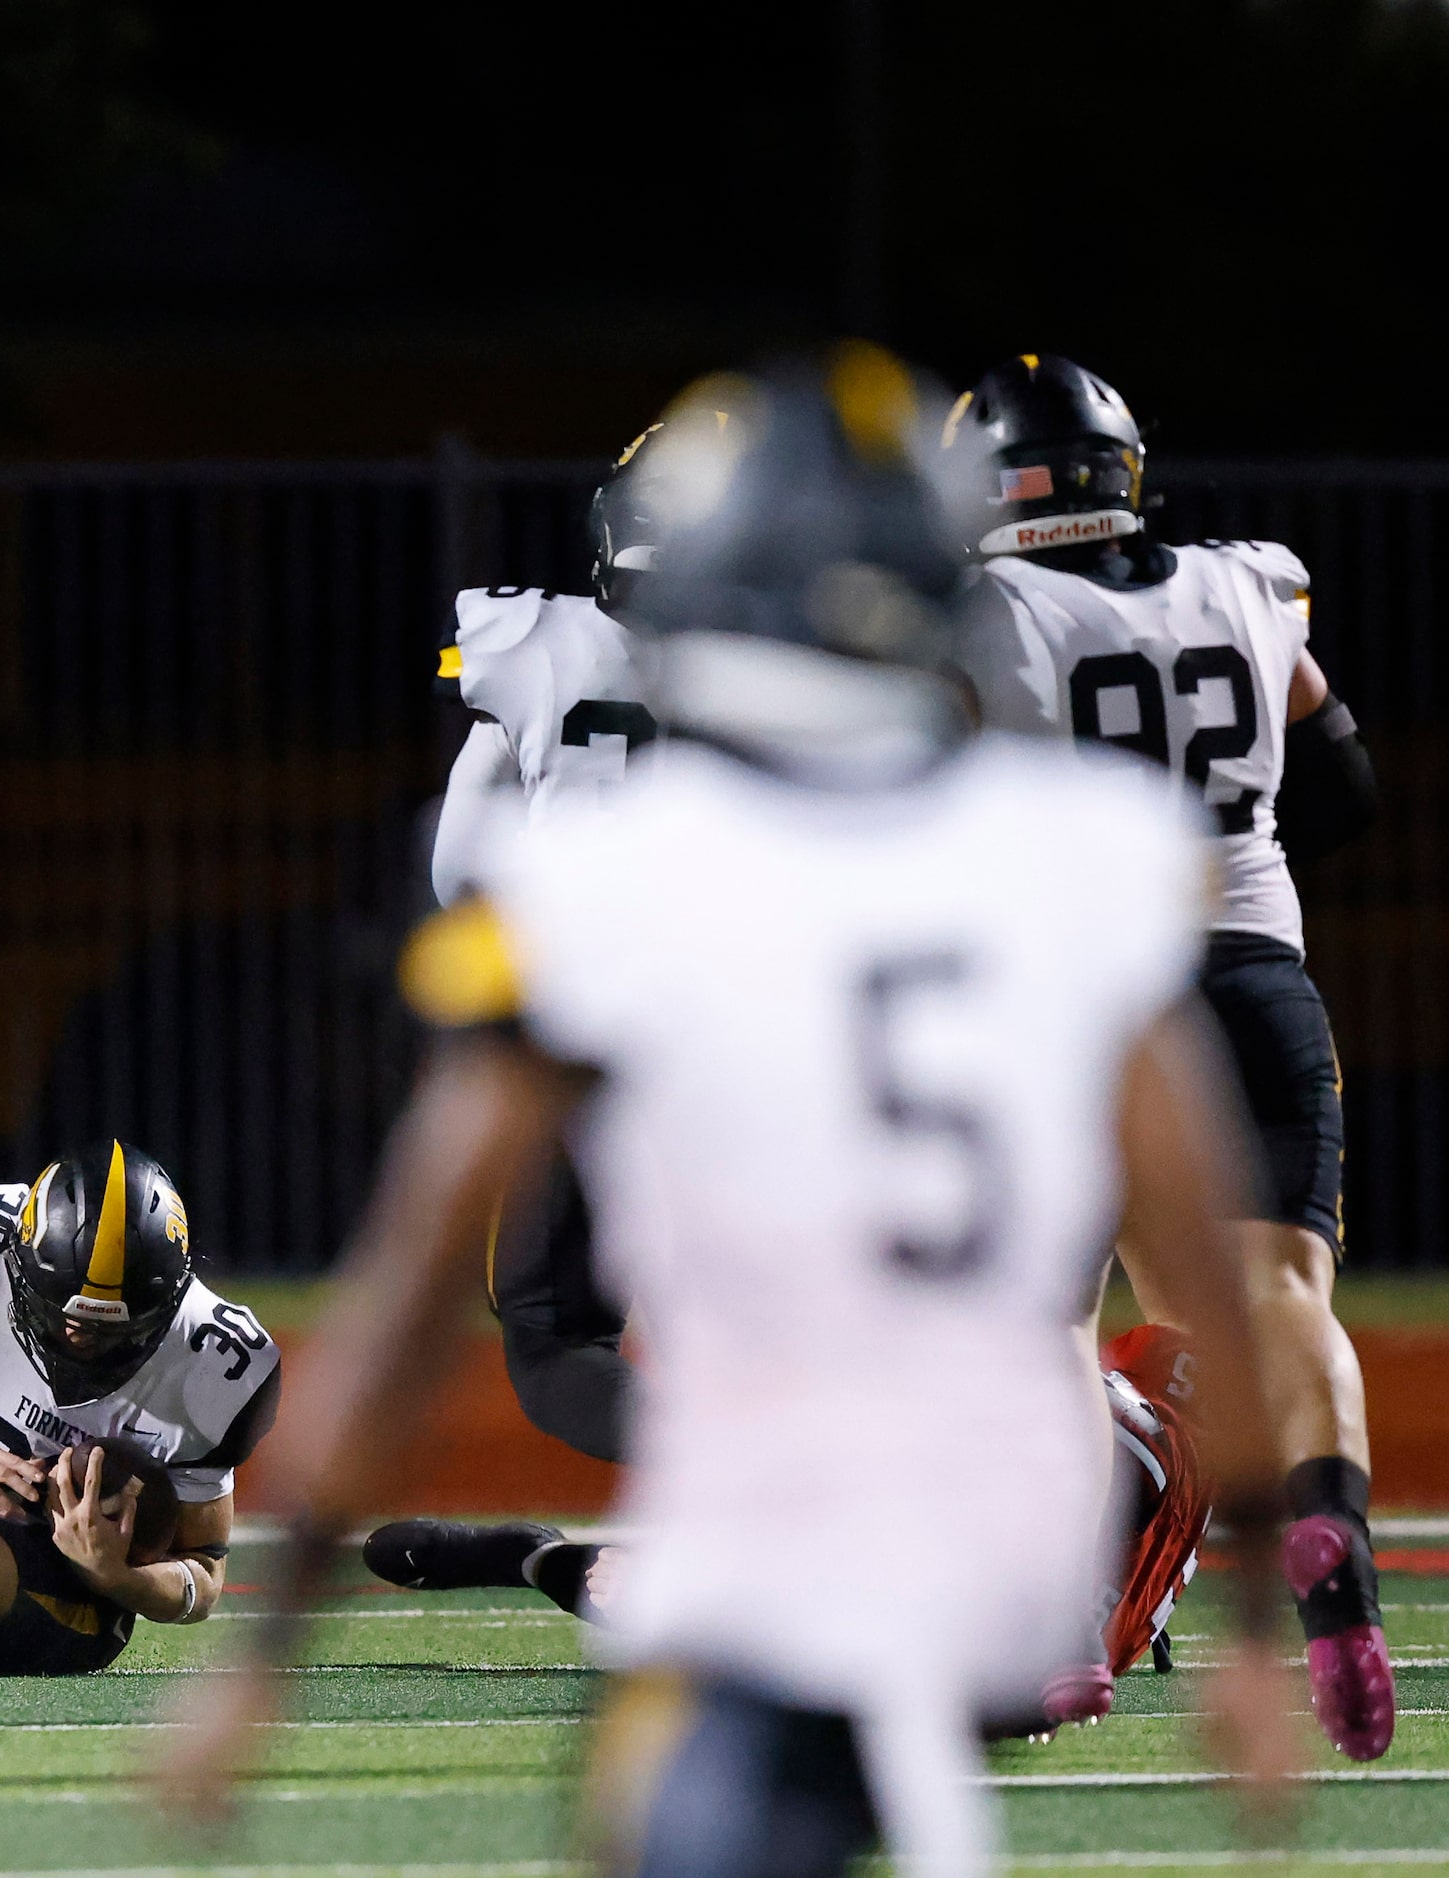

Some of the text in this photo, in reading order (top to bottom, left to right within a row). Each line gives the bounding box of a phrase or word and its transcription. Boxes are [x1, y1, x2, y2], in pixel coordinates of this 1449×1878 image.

[1016, 514, 1113, 545] Riddell
[1070, 645, 1259, 836] 92
[854, 935, 1016, 1288] 5
[190, 1302, 269, 1381] 30
